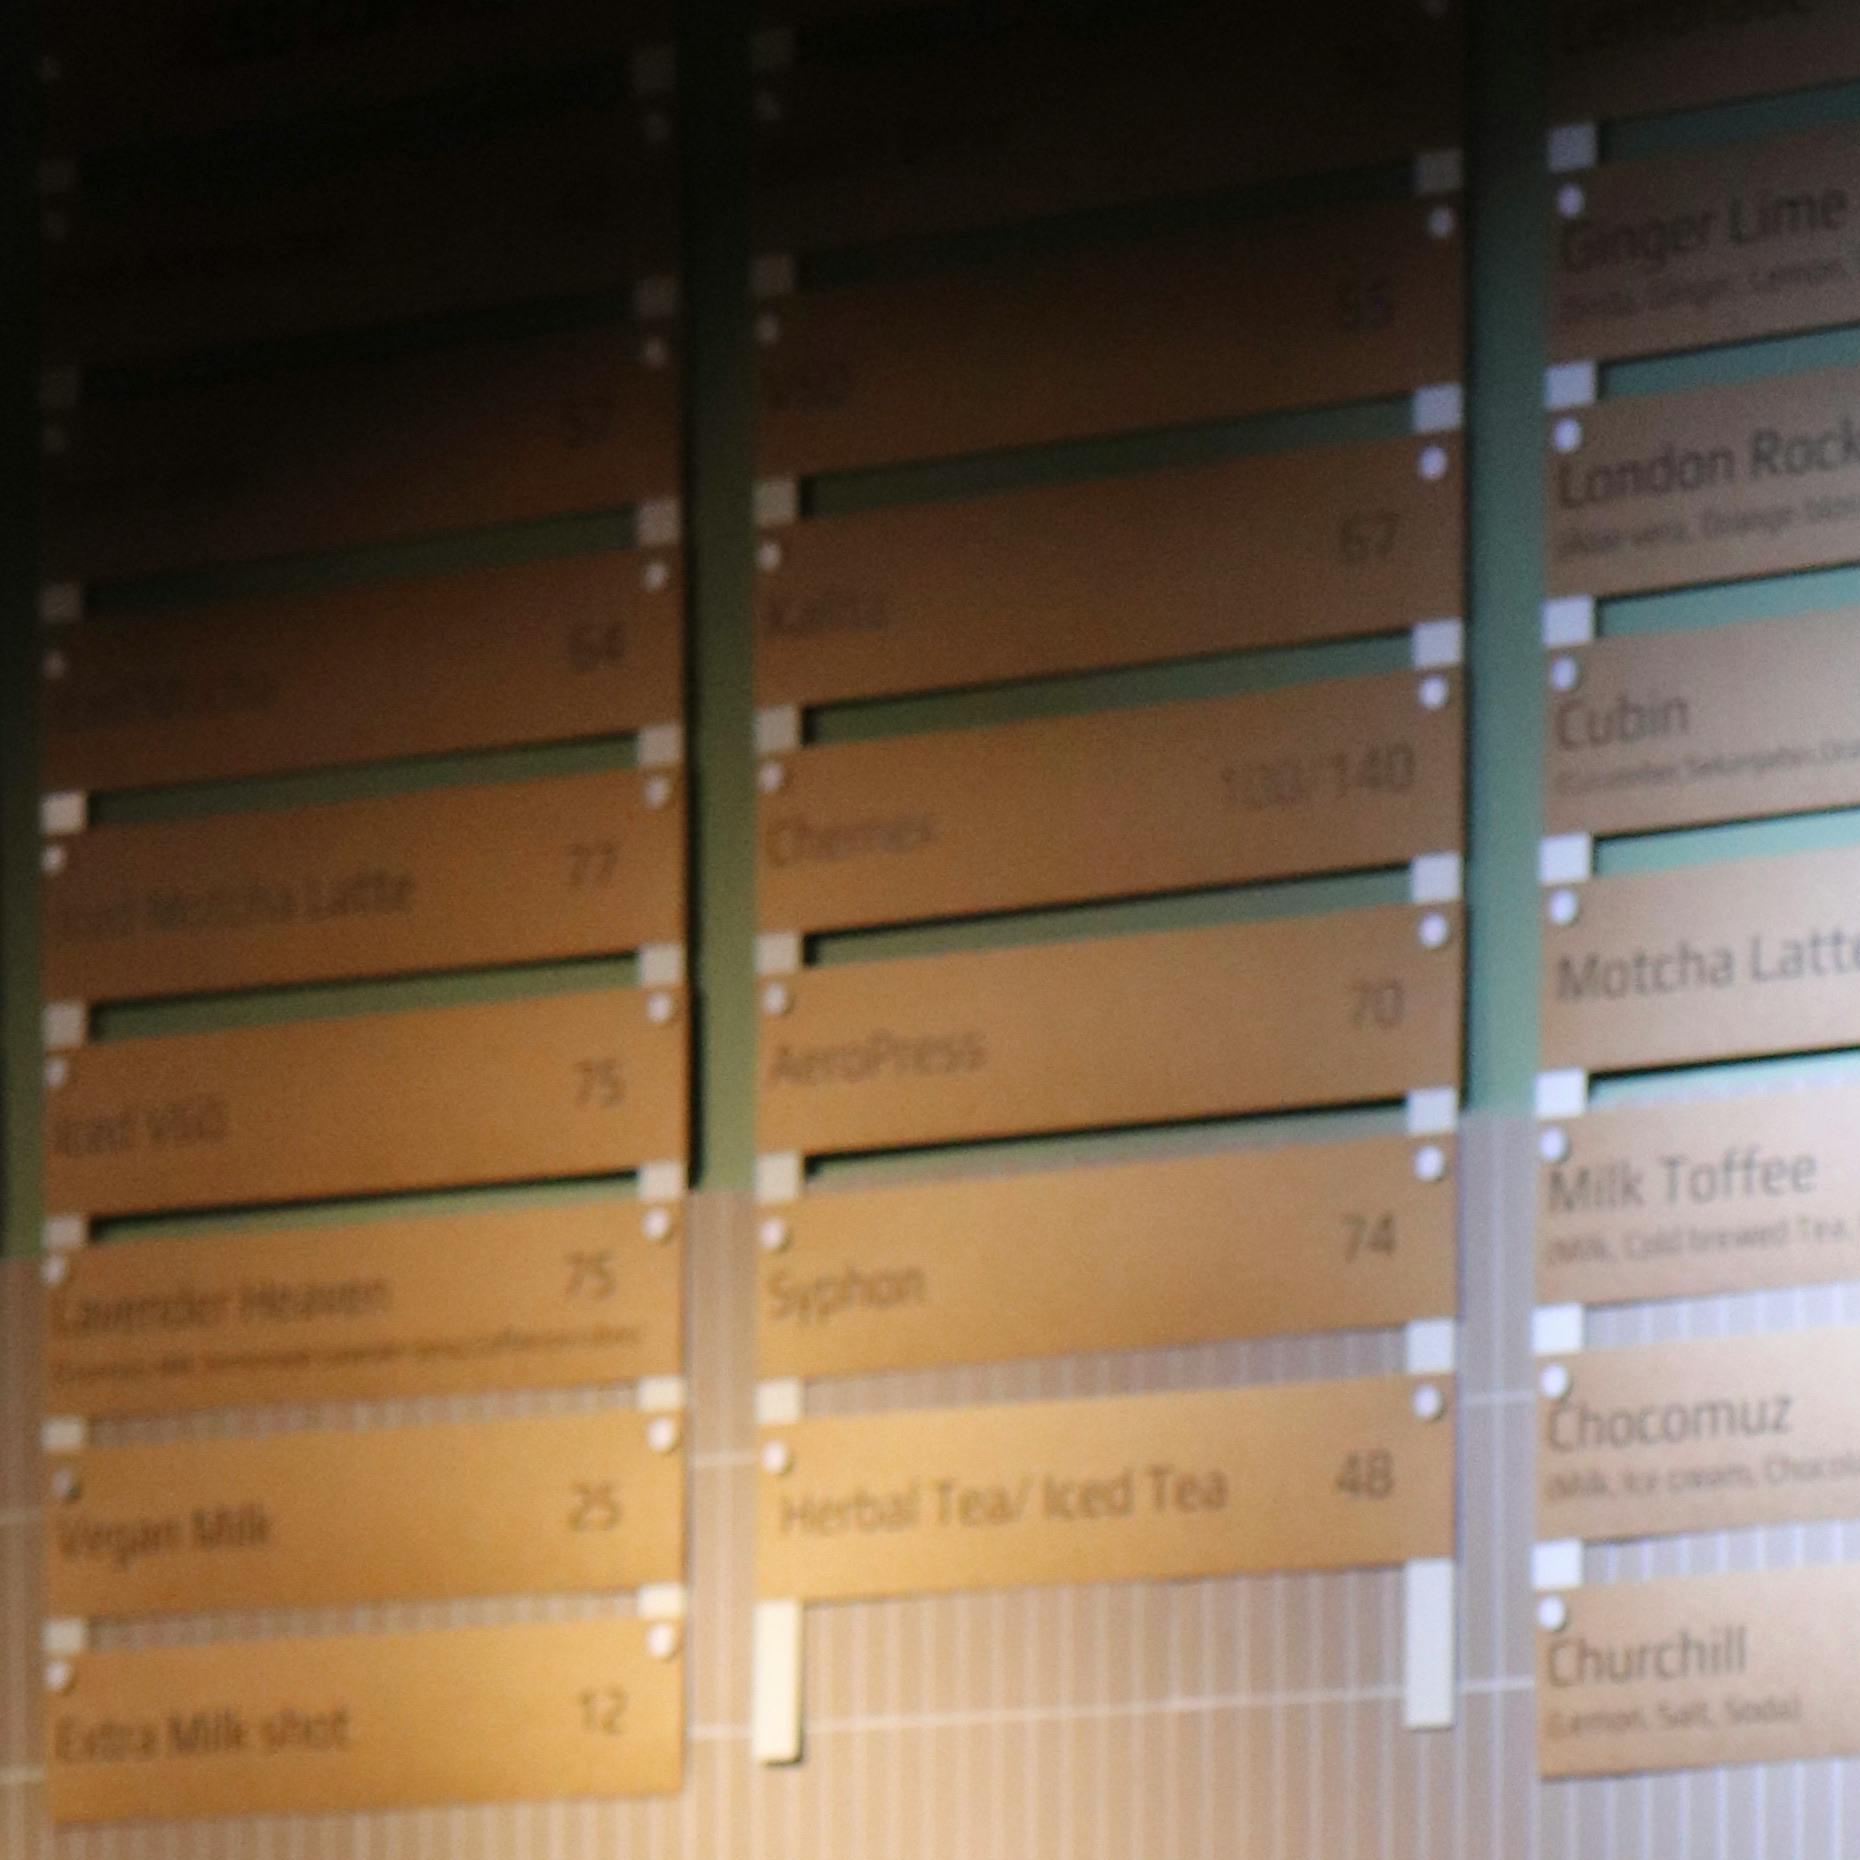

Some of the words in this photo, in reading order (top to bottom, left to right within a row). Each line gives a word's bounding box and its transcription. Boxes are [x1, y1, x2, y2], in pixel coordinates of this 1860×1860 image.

[1546, 1156, 1645, 1214] Milk
[1657, 1144, 1820, 1204] Toffee
[1344, 1214, 1398, 1264] 74
[765, 1263, 928, 1330] Syphon
[1543, 1392, 1796, 1451] Chocomuz
[568, 1477, 622, 1532] 25
[778, 1478, 919, 1537] Herbal
[1042, 1466, 1135, 1520] Iced
[1145, 1464, 1231, 1514] Tea
[1333, 1449, 1396, 1501] 48
[1543, 1624, 1748, 1689] Churchill
[578, 1682, 627, 1736] 12
